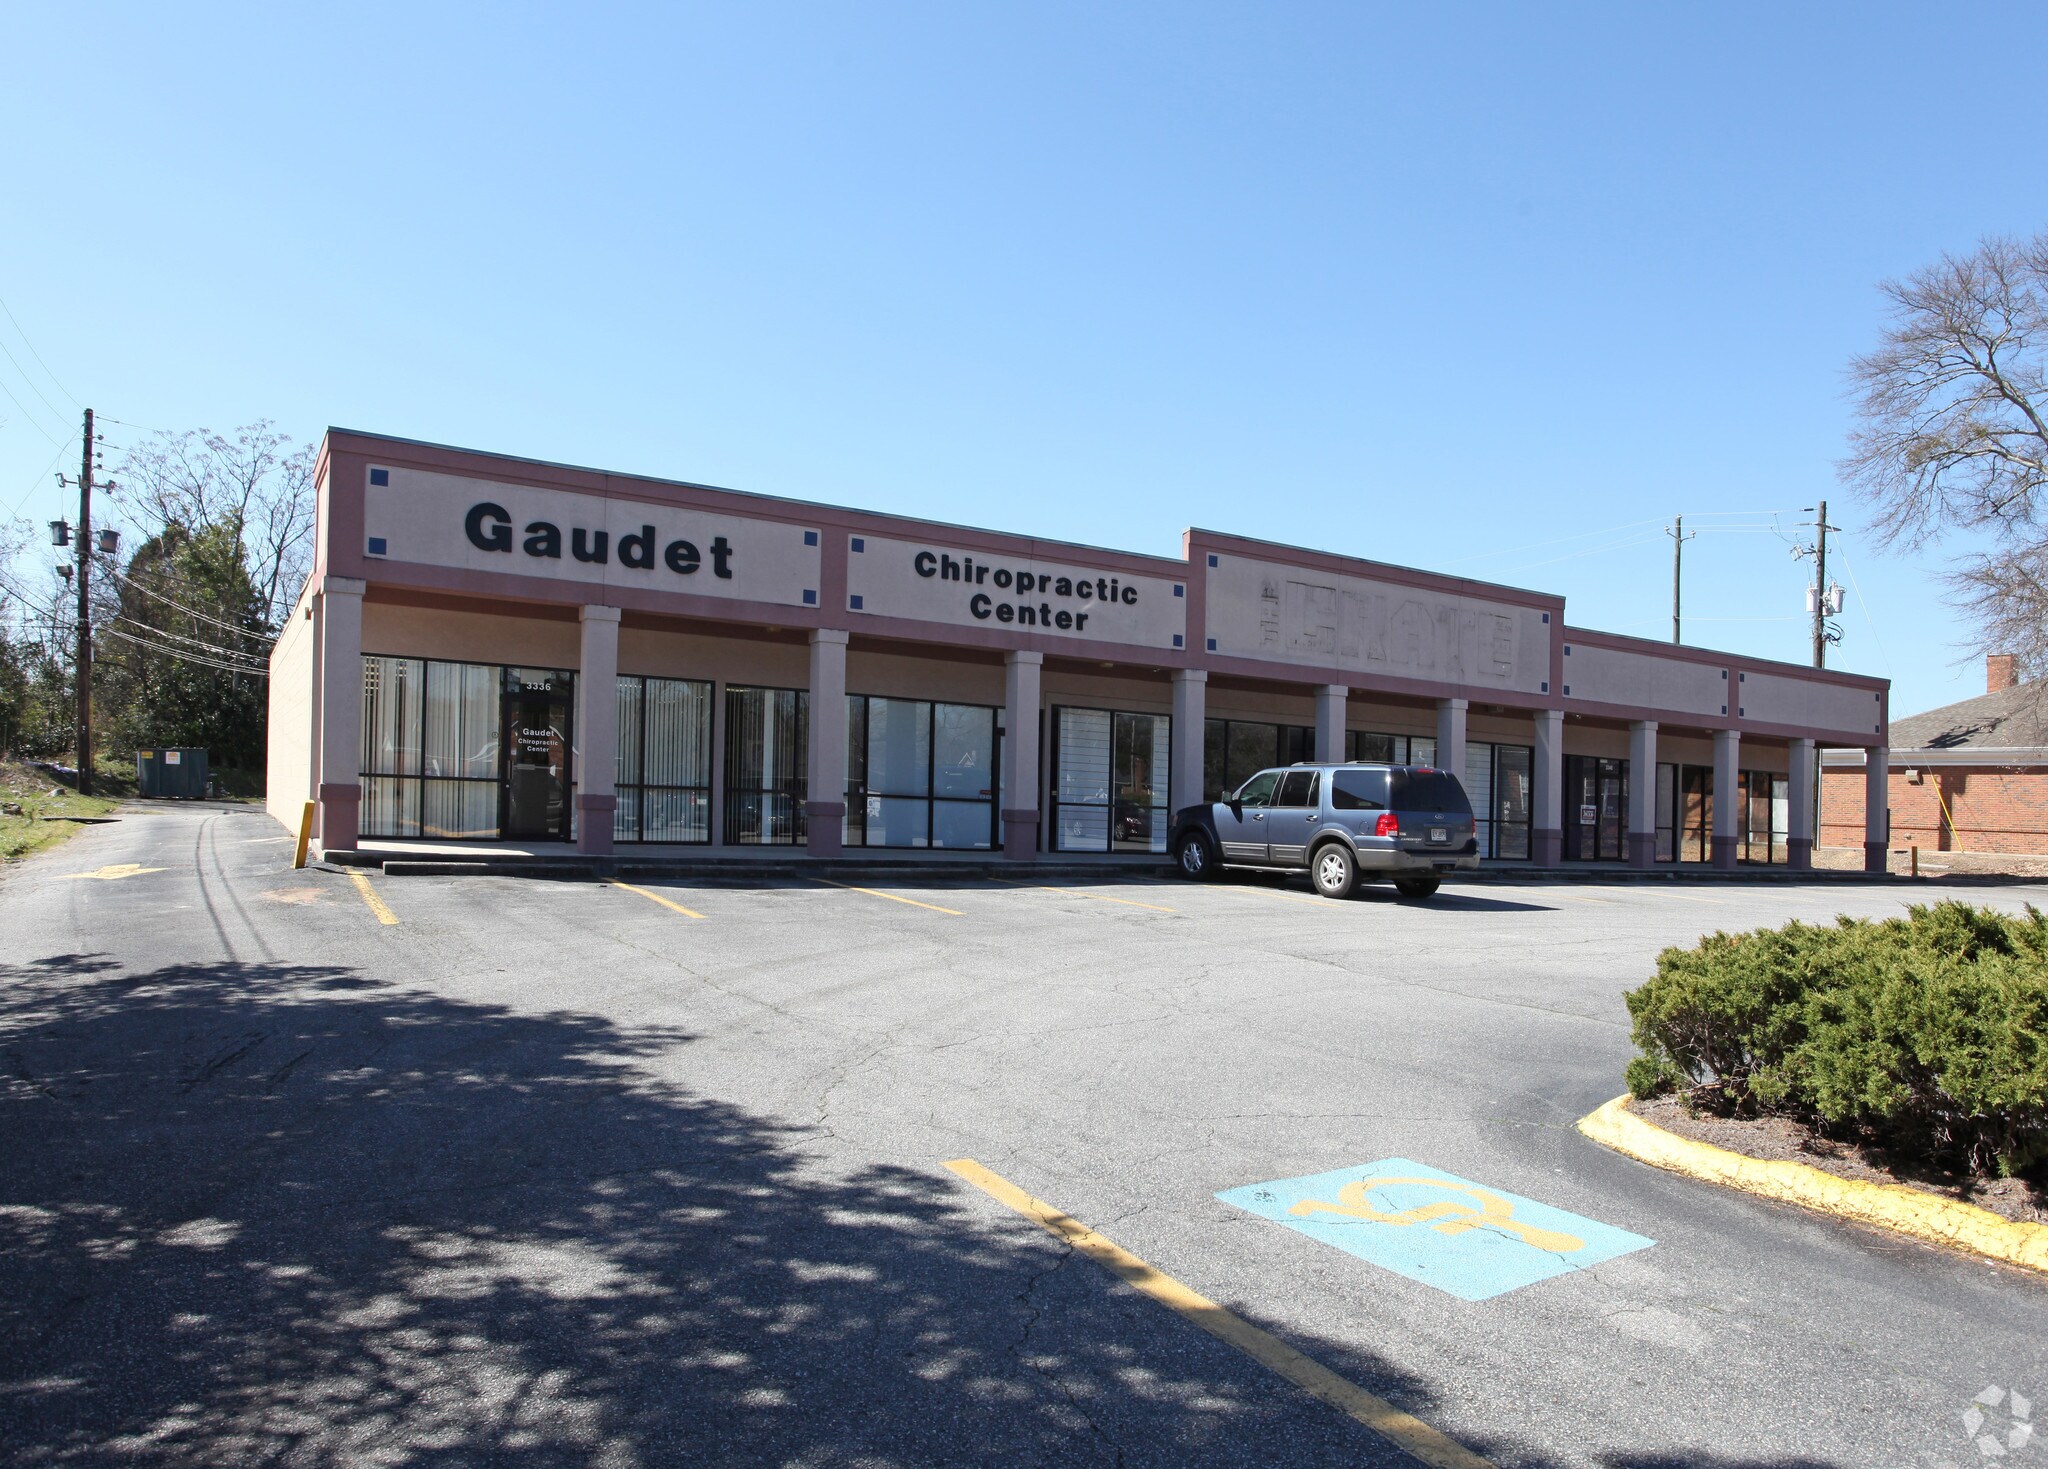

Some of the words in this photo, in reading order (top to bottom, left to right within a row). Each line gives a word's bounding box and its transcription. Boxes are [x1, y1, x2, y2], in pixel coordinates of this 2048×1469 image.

[464, 502, 733, 579] Gaudet
[914, 551, 1138, 605] Chiropractic
[970, 593, 1089, 631] Center
[526, 681, 551, 691] 3336
[518, 738, 558, 746] Chiropractic
[523, 728, 554, 737] Gaudet
